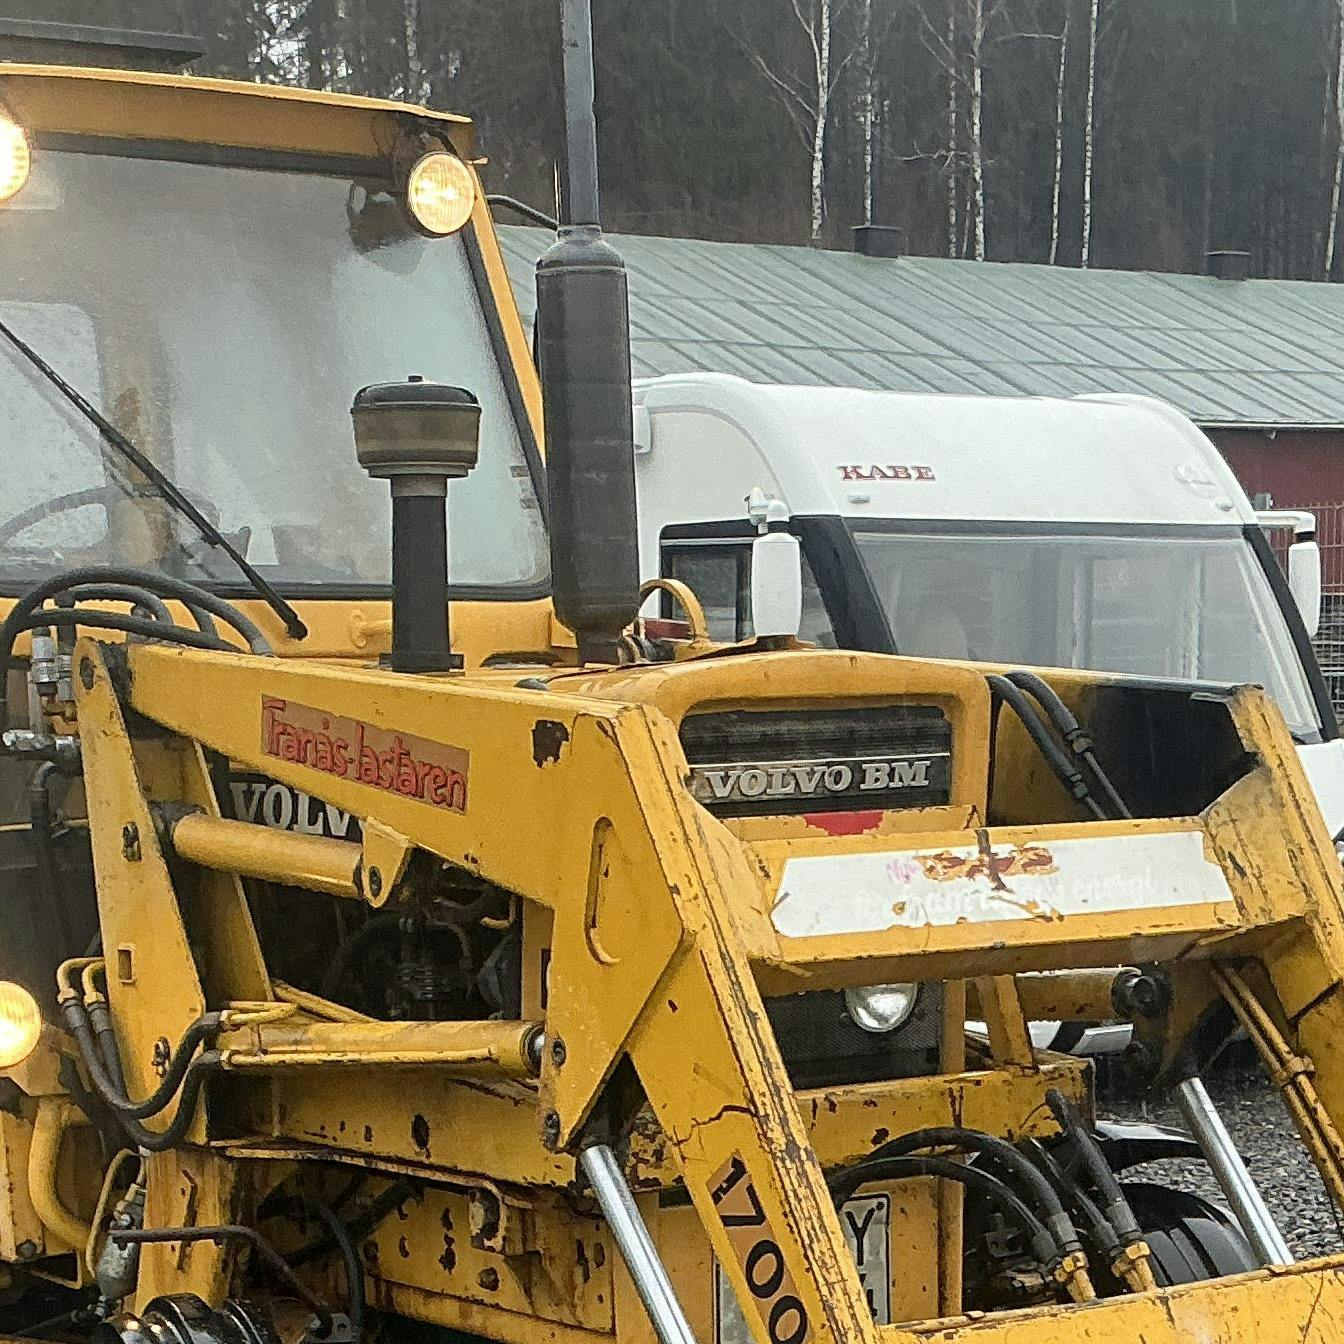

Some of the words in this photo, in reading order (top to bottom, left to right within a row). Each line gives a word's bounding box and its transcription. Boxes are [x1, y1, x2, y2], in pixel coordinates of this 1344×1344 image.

[836, 465, 936, 481] KABE
[704, 764, 853, 798] VOLVO
[859, 760, 932, 791] BM
[230, 782, 365, 838] VOLV
